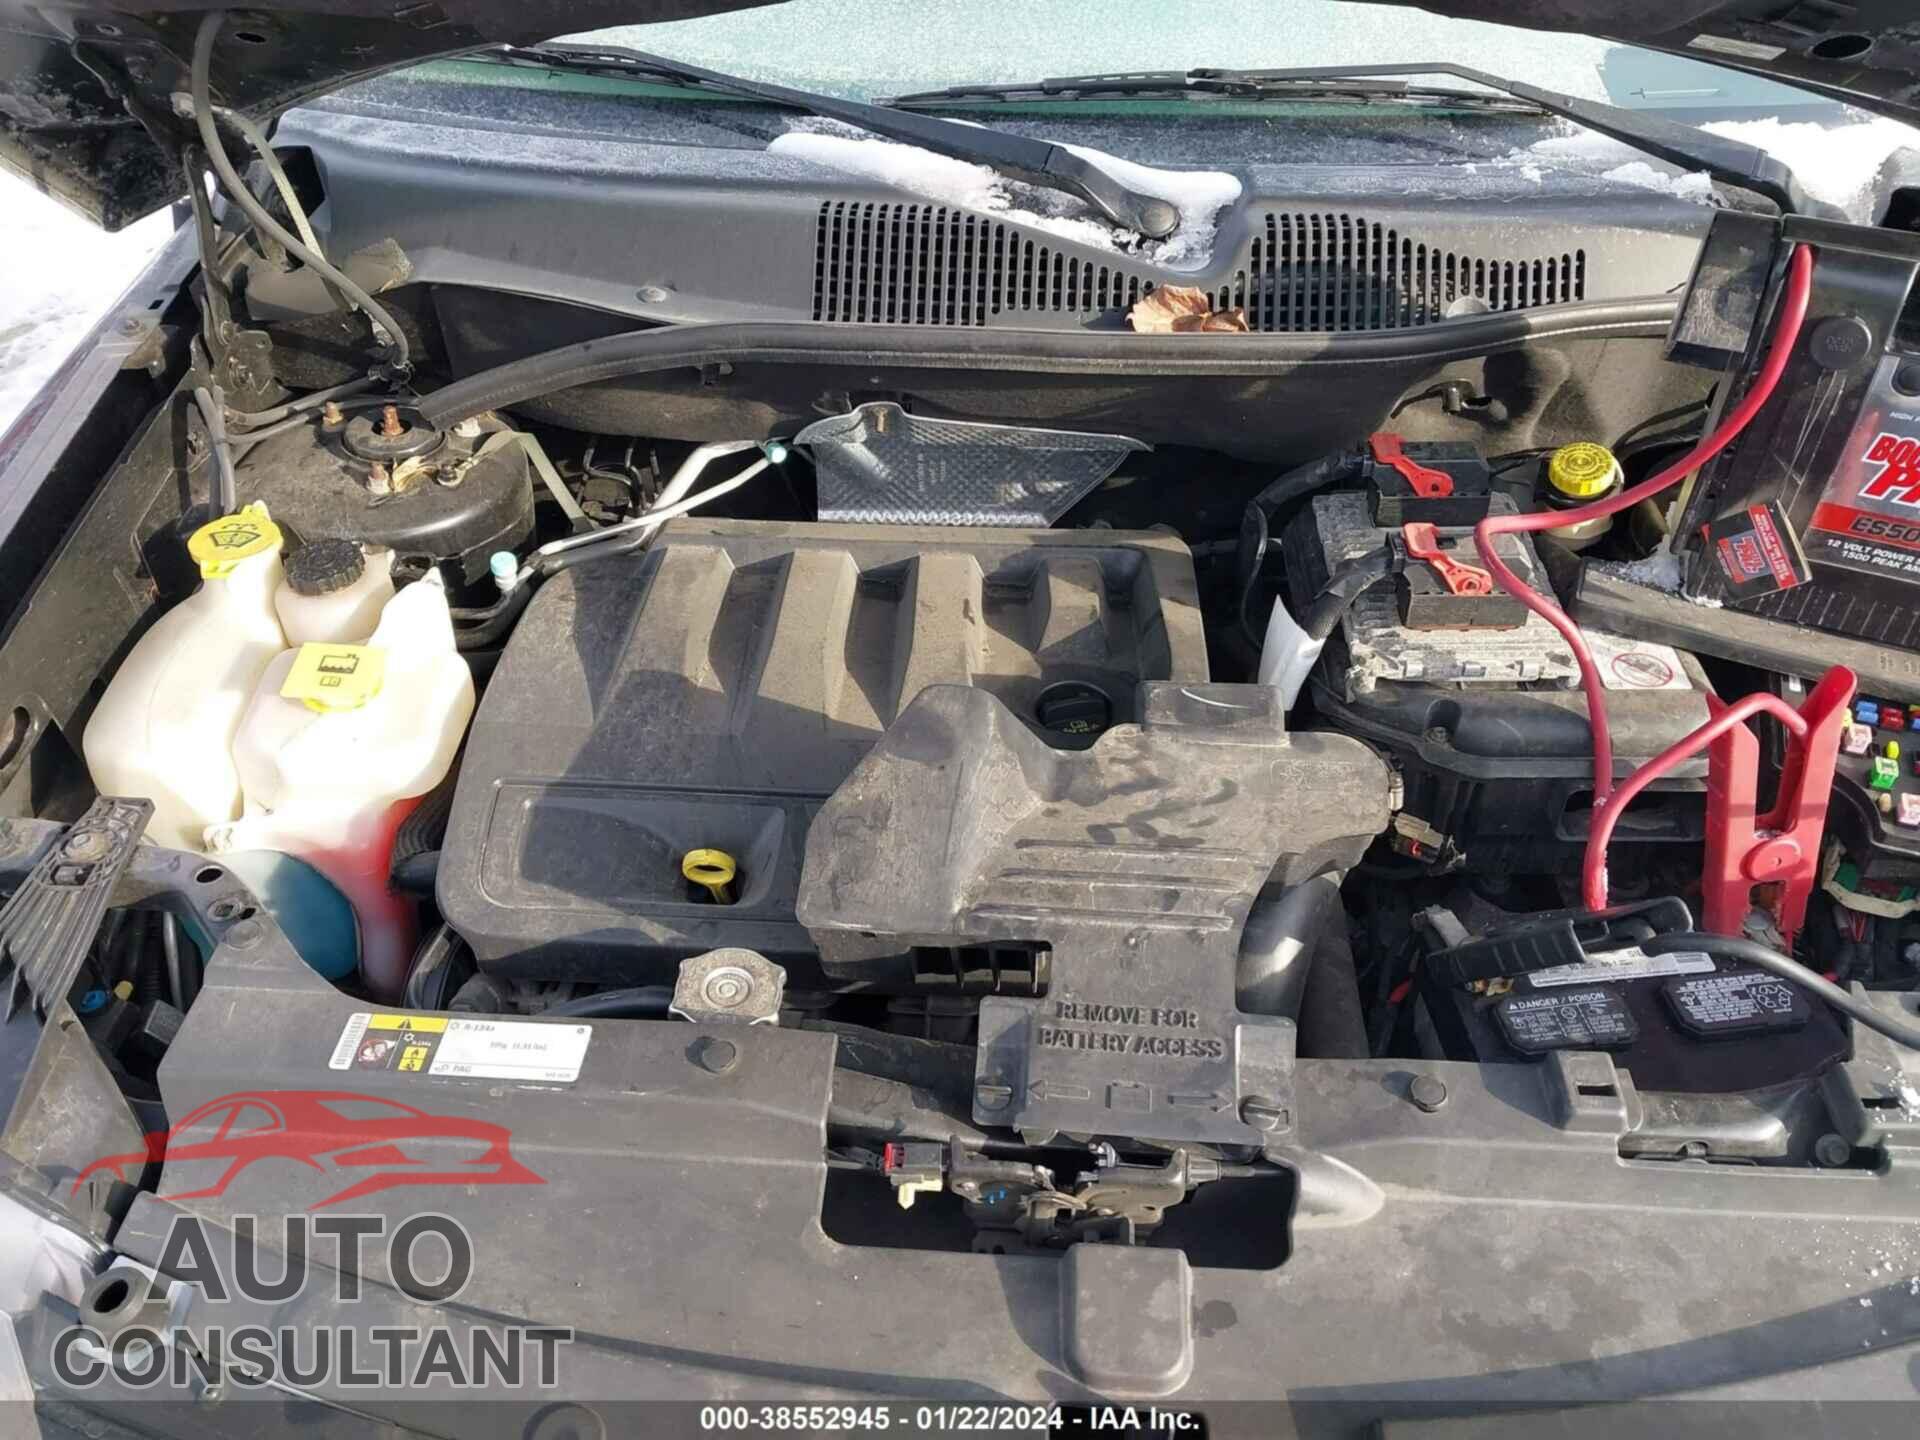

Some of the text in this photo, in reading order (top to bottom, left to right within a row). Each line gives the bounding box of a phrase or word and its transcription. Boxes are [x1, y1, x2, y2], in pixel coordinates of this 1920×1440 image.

[1827, 539, 1841, 548] 12
[1843, 542, 1872, 553] VOLT
[1871, 548, 1915, 563] POWER
[1842, 550, 1870, 562] 1500
[1871, 556, 1902, 568] PEAK
[1518, 998, 1560, 1010] DANGER
[1567, 992, 1606, 1003] POISON
[1056, 1001, 1199, 1029] REMOVE FOR
[1038, 1028, 1224, 1060] BATTERY ACCESS
